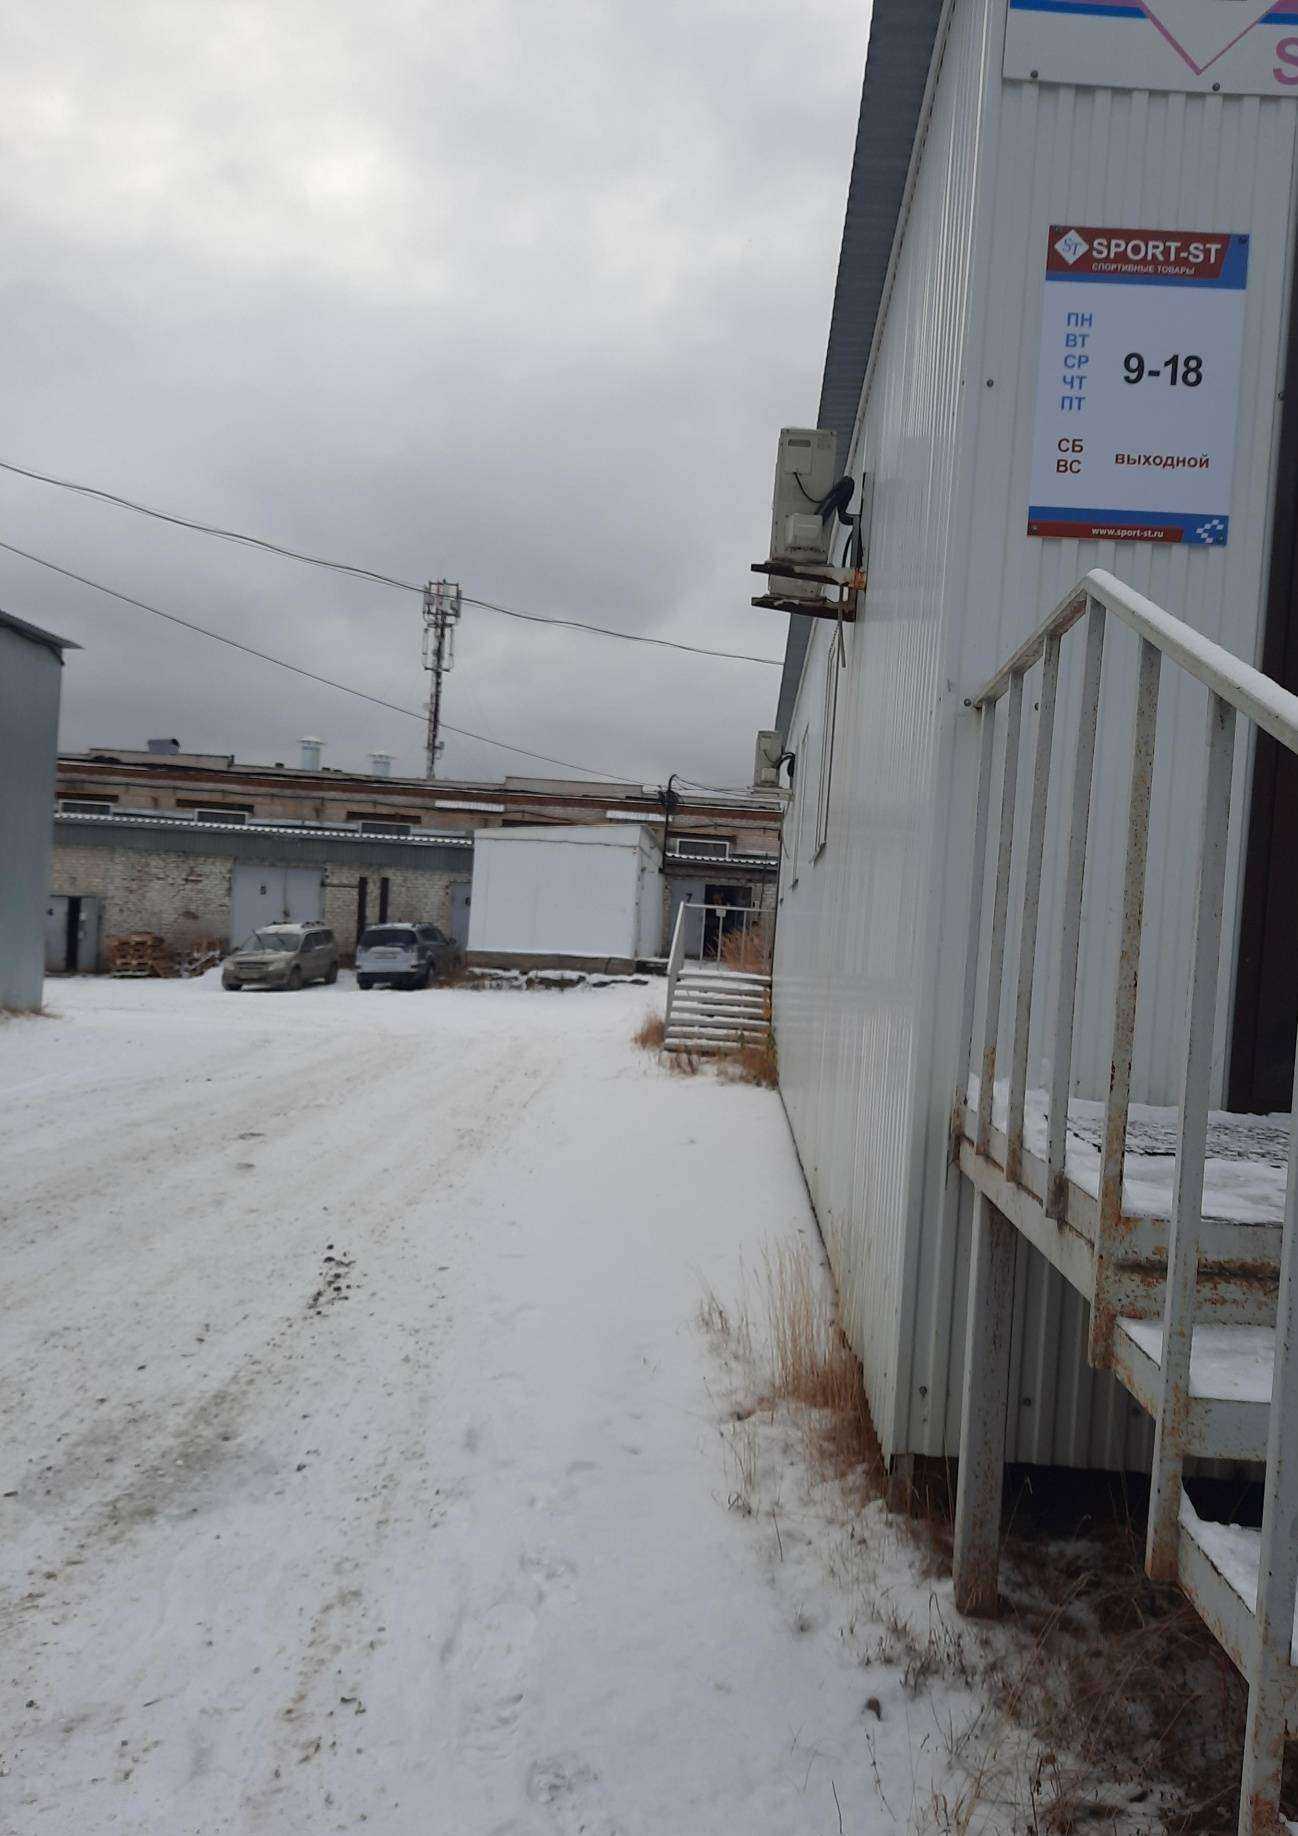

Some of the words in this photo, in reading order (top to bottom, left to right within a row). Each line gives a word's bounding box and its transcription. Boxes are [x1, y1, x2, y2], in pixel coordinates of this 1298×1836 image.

[1092, 238, 1222, 264] SPORT-ST
[1092, 262, 1154, 274] СПОРТИВНЫЕ
[1157, 264, 1195, 275] ТОВАРЫ
[1066, 312, 1093, 328] ПН
[1065, 333, 1090, 348] ВТ
[1063, 354, 1089, 369] СР
[1123, 352, 1203, 387] 9-18
[1062, 375, 1087, 390] ЧТ
[1060, 396, 1086, 411] ПТ
[1057, 437, 1084, 453] СБ
[1056, 459, 1082, 474] ВС
[1092, 526, 1164, 538] www.sport-st.ru
